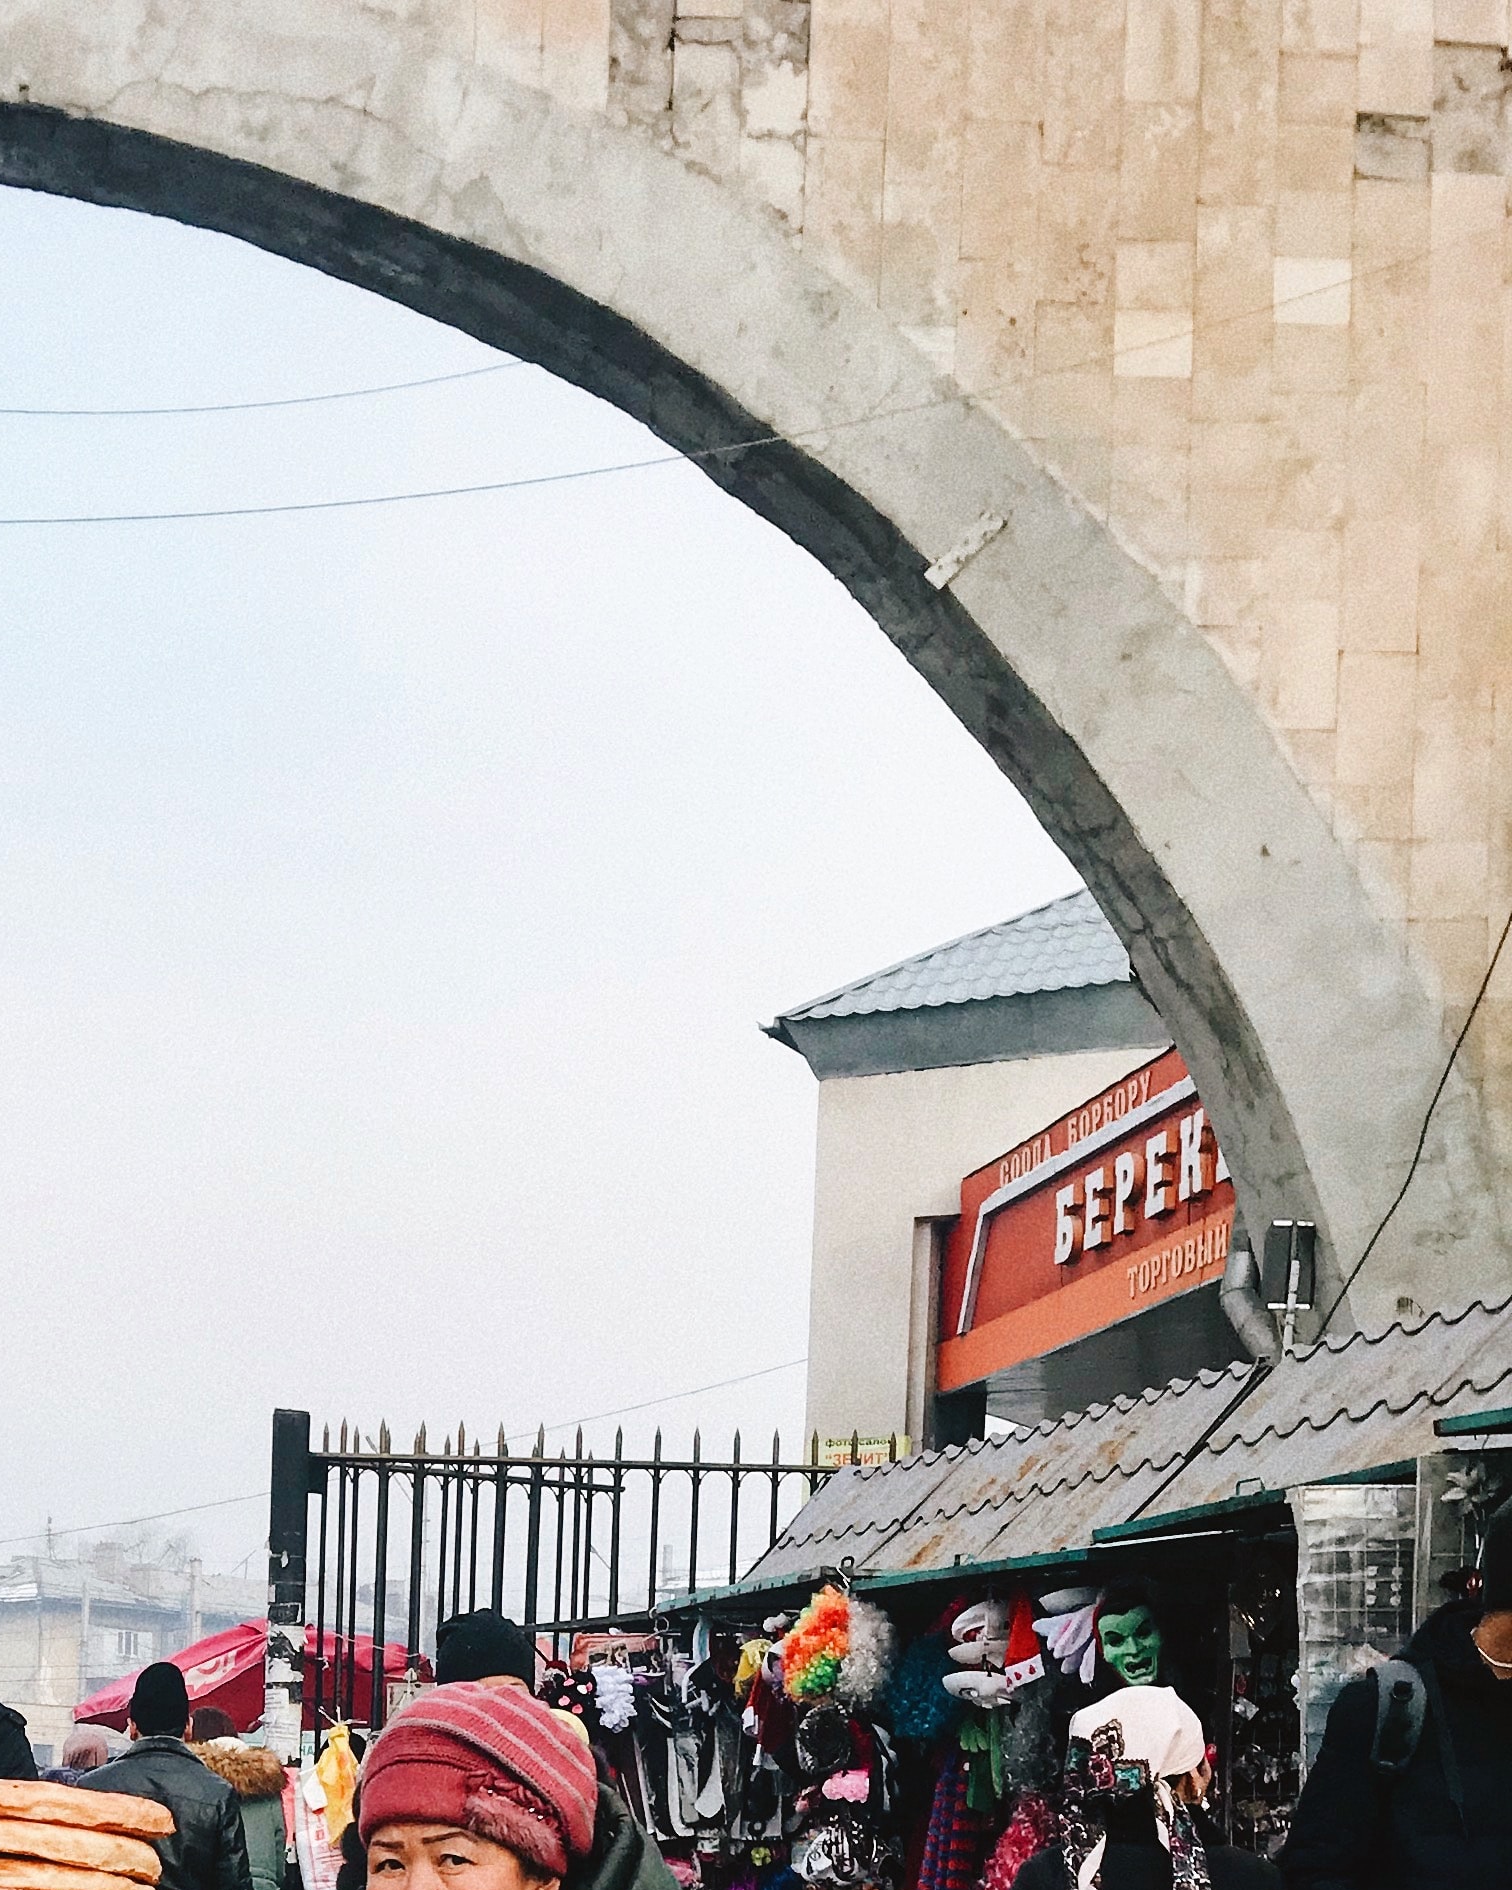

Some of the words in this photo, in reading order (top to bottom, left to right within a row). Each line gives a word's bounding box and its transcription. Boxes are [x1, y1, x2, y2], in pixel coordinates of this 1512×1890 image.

[1067, 1070, 1152, 1148] БОРБОРУ
[1053, 1108, 1231, 1266] БЕРЕК
[1127, 1218, 1229, 1299] ТОРГОВЫЙ
